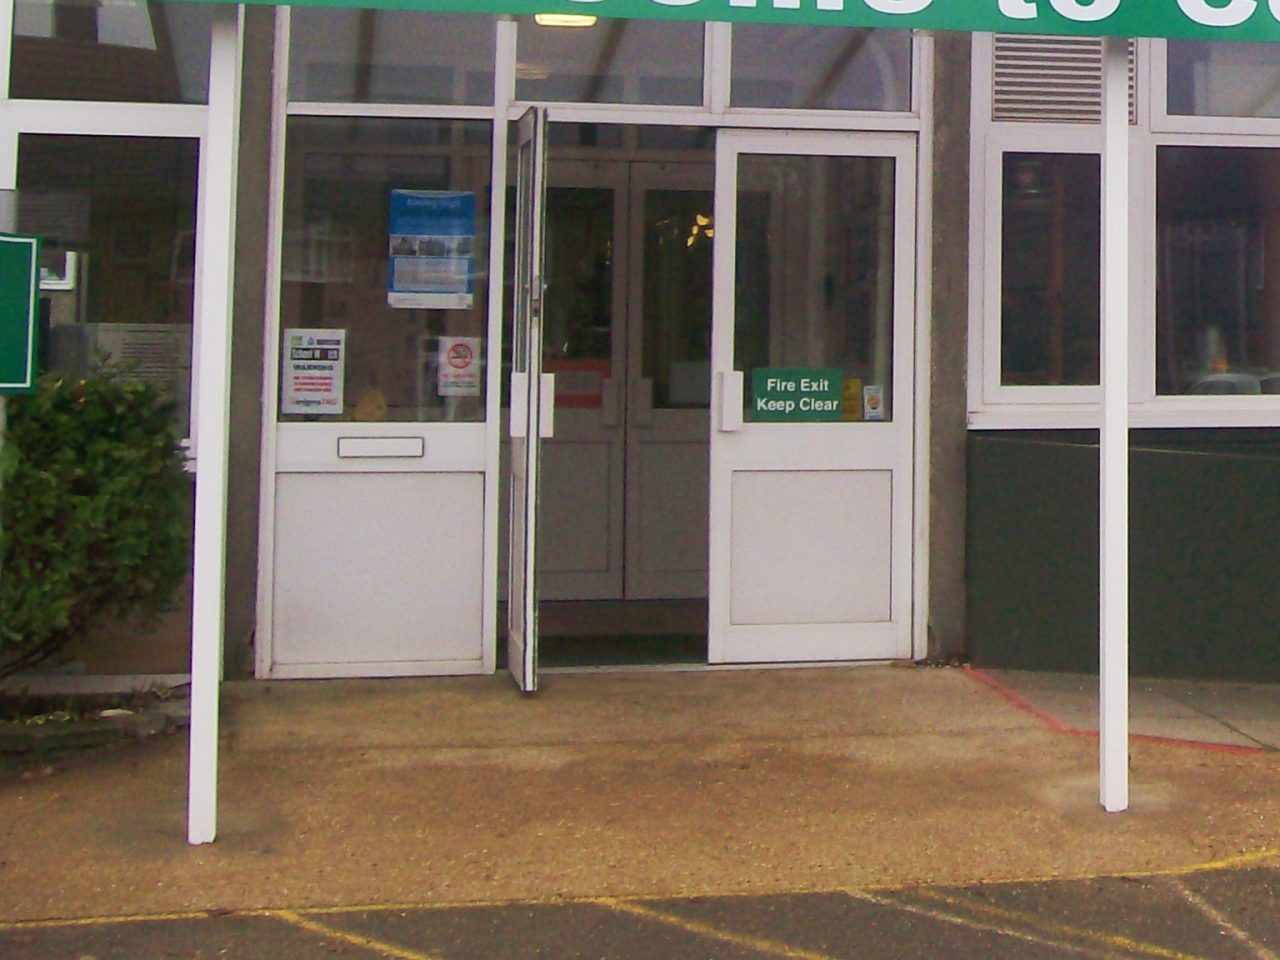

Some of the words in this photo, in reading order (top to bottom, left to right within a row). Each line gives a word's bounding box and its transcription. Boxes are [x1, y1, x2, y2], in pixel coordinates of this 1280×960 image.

[767, 378, 796, 392] Fire
[800, 378, 829, 392] Exit
[756, 397, 795, 414] Keep
[799, 397, 839, 411] Clear
